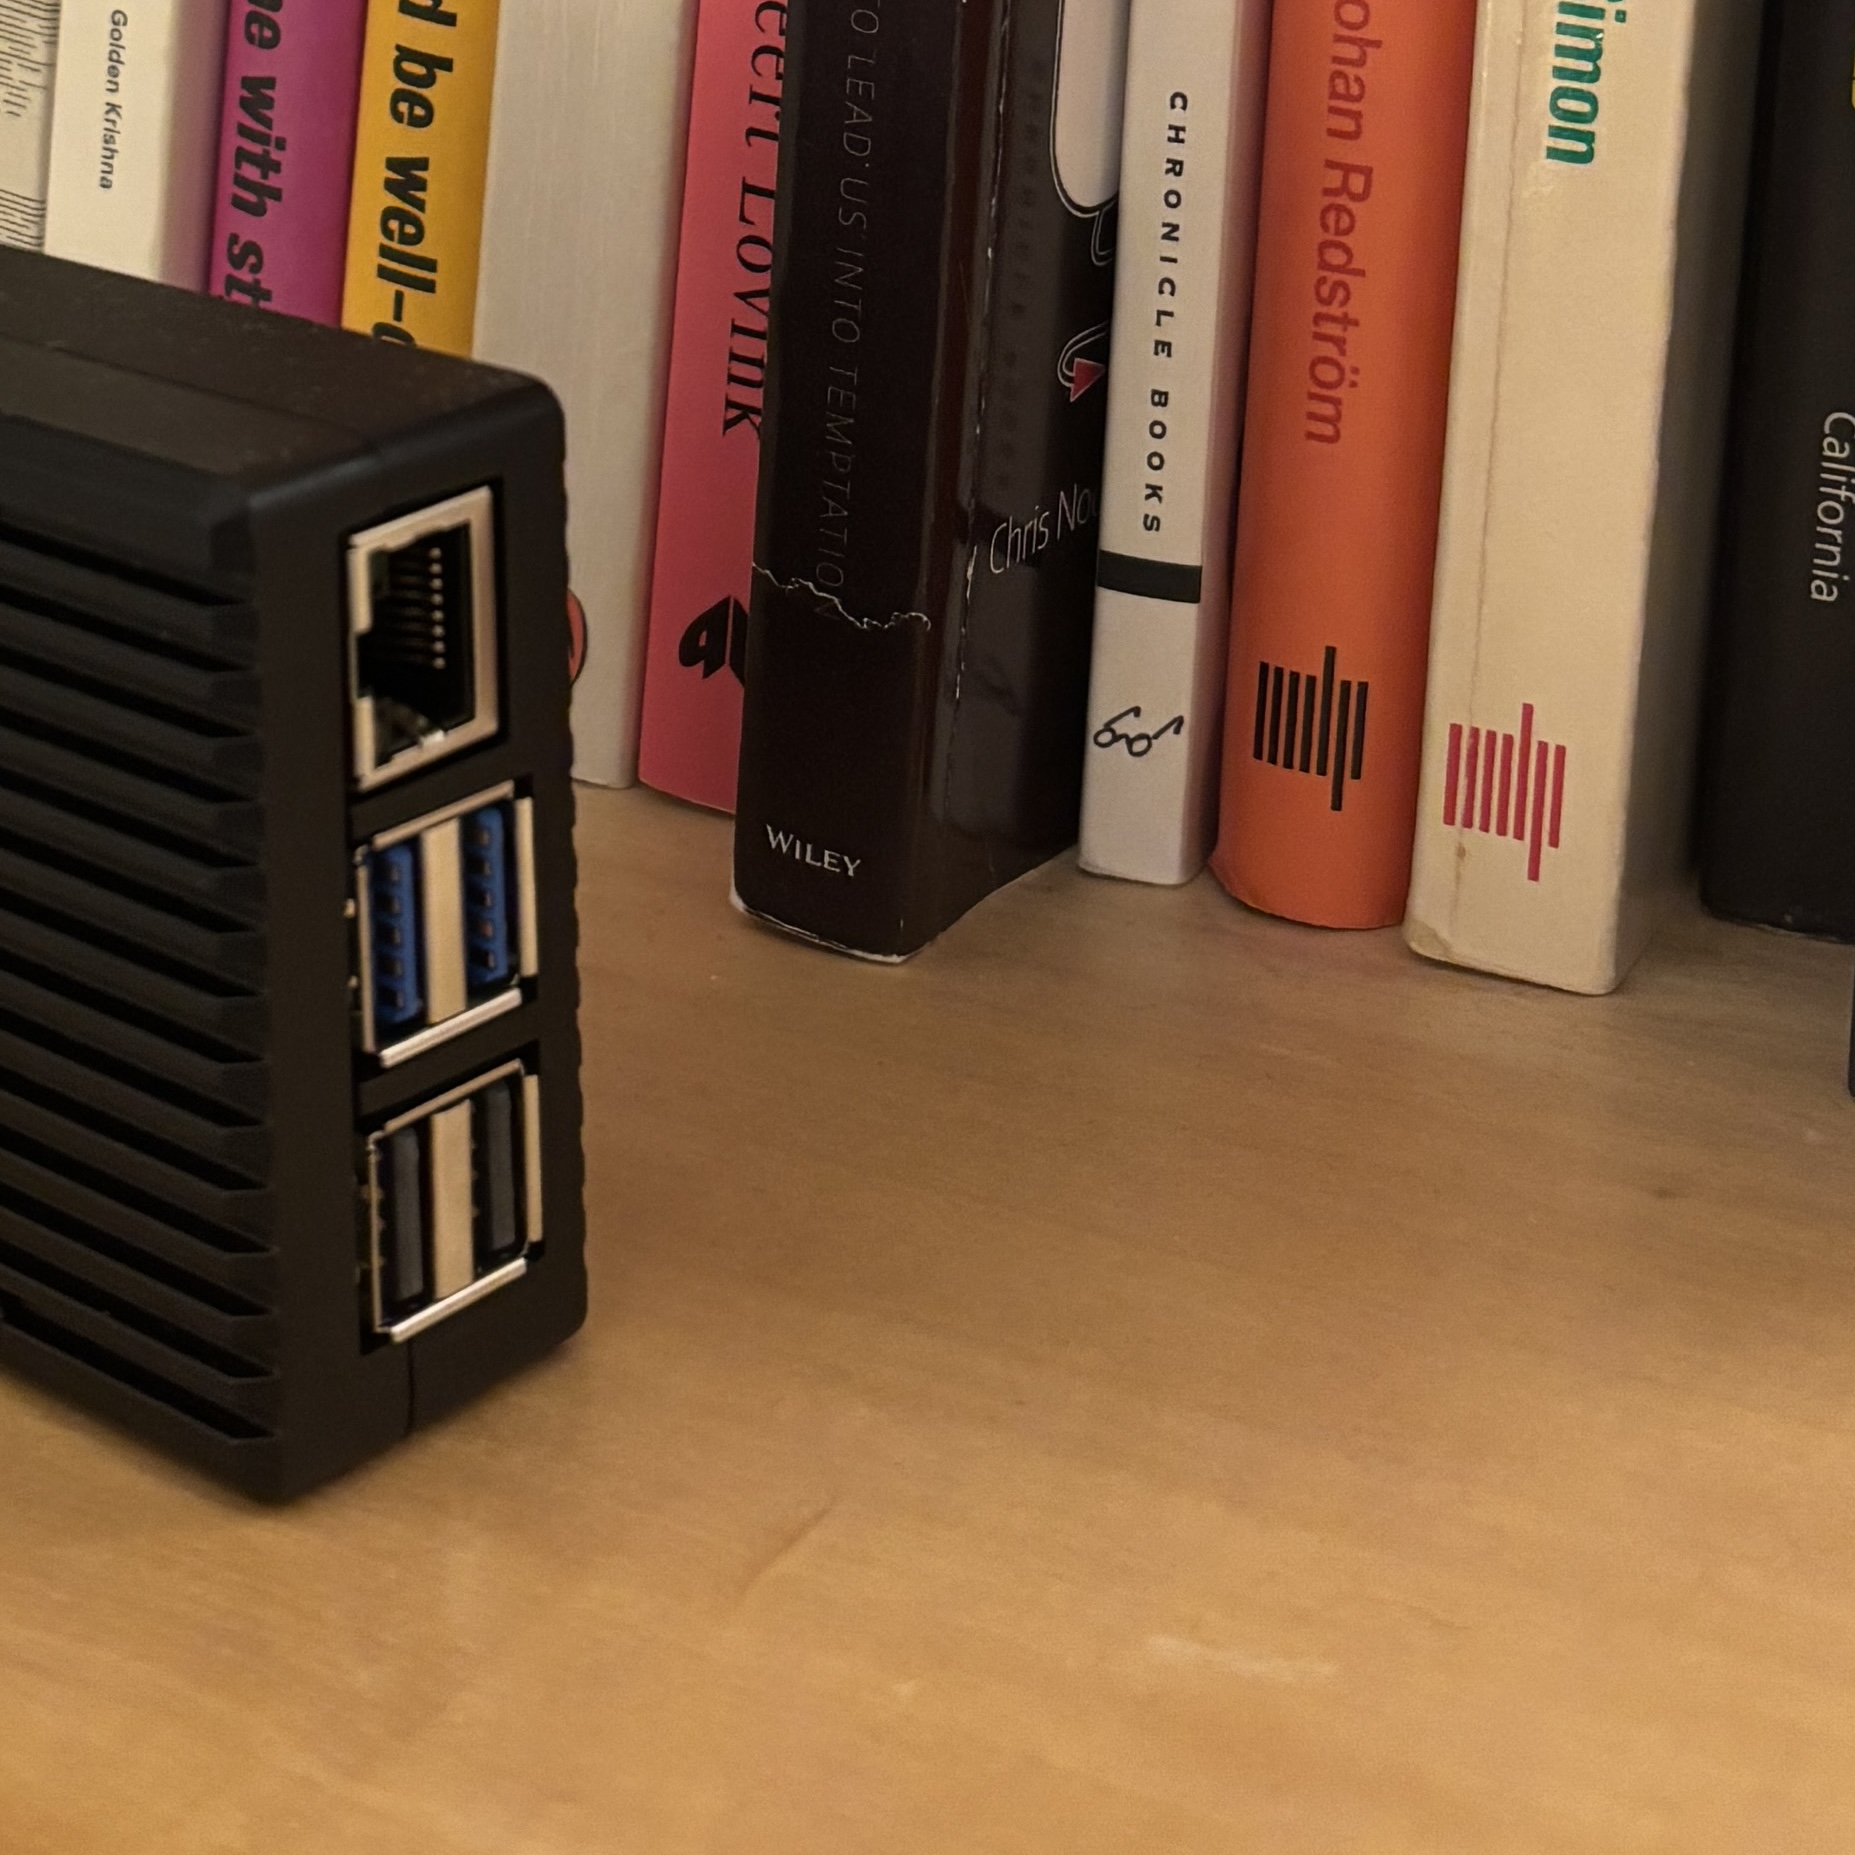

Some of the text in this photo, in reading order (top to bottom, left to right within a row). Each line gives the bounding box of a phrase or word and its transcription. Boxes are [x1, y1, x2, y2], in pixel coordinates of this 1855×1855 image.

[99, 9, 129, 190] Golden Krishna
[229, 76, 286, 217] with
[390, 45, 453, 127] be
[843, 50, 877, 156] LEAD
[838, 175, 871, 227] US
[722, 177, 778, 435] Lovink
[831, 245, 865, 343] INTO
[1142, 92, 1189, 533] CHRONICLE BOOKS
[1305, 158, 1374, 443] Redström
[812, 364, 860, 621] TEMPTATION
[989, 505, 1050, 575] Chris
[1810, 412, 1855, 602] California
[765, 822, 861, 877] WILEY
